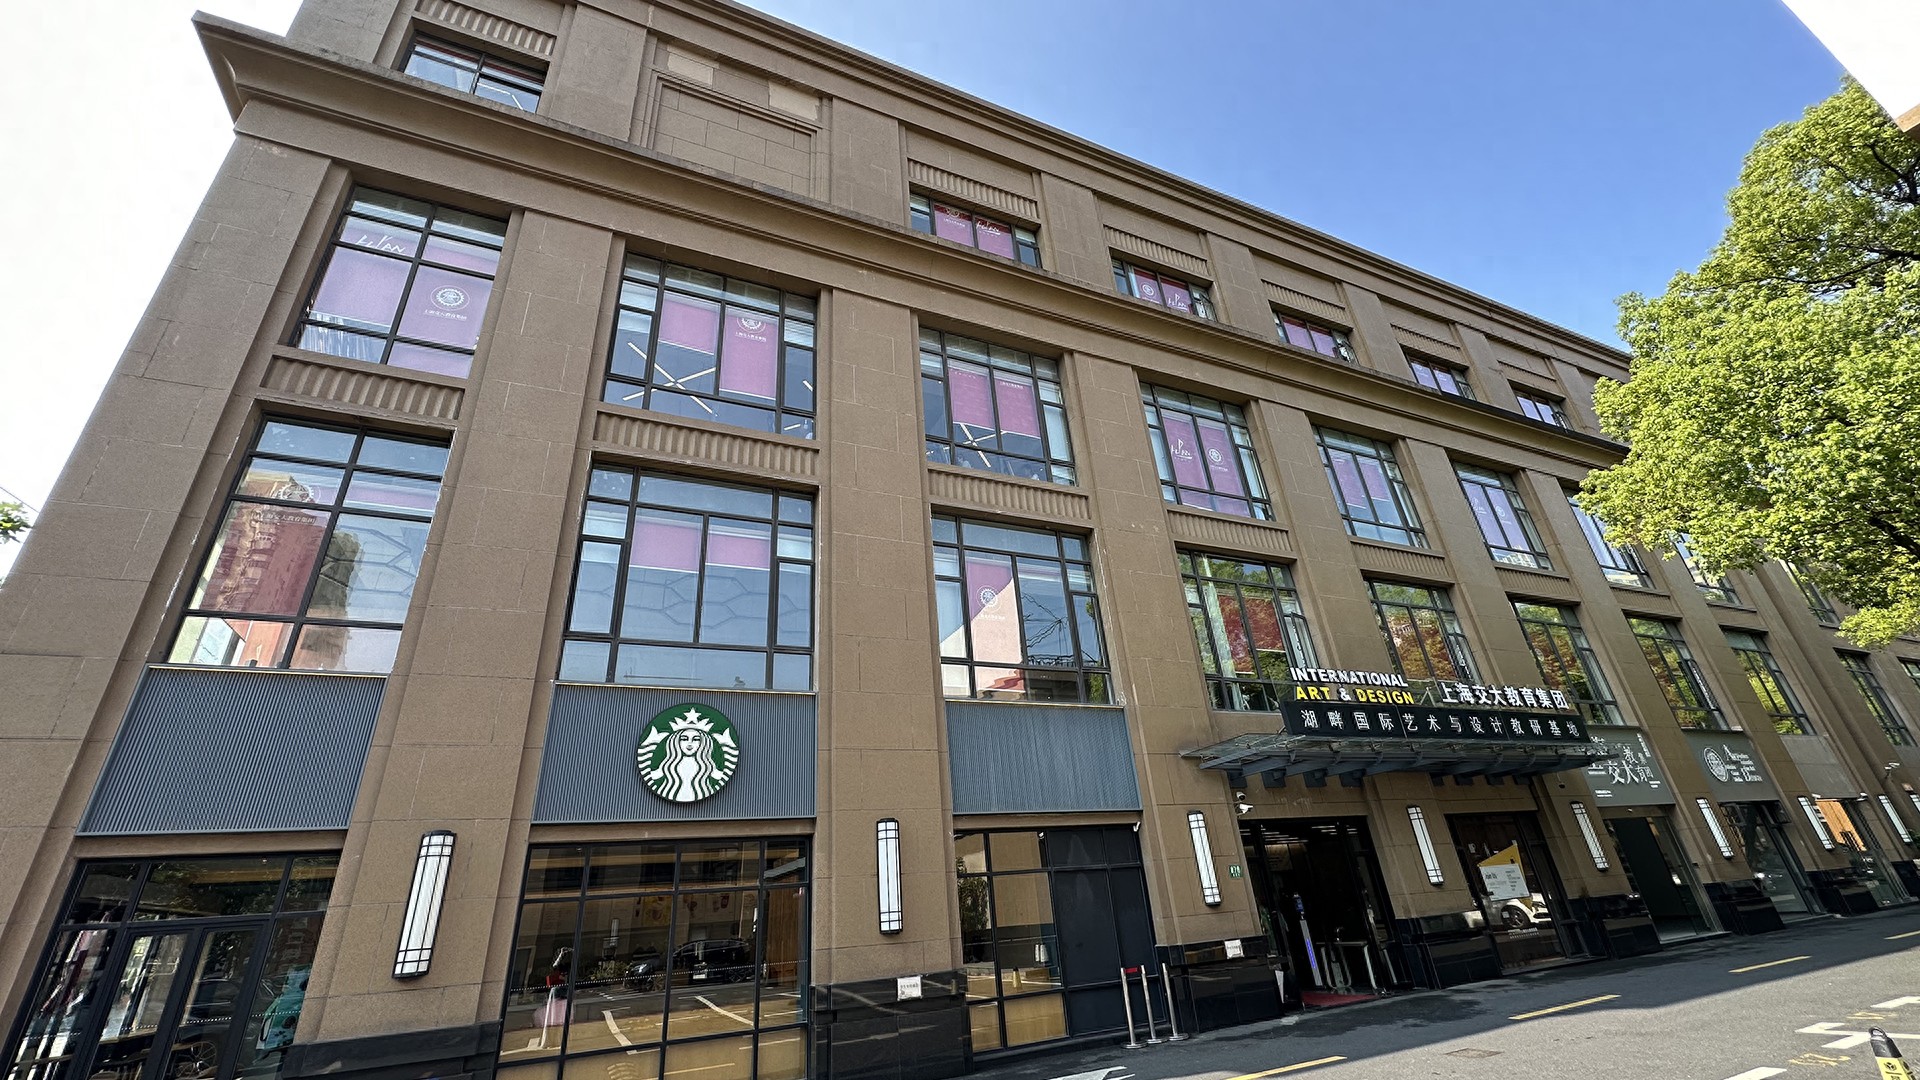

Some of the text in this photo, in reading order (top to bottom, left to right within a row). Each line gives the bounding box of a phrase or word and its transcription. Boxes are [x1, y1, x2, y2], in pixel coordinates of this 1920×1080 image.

[1290, 667, 1408, 687] INTERNATIONAL
[1296, 686, 1415, 705] ART & DESIGN
[1440, 682, 1569, 709] 上海交大教育集团
[1301, 709, 1580, 737] 湖畔国际艺术与设计教研基地
